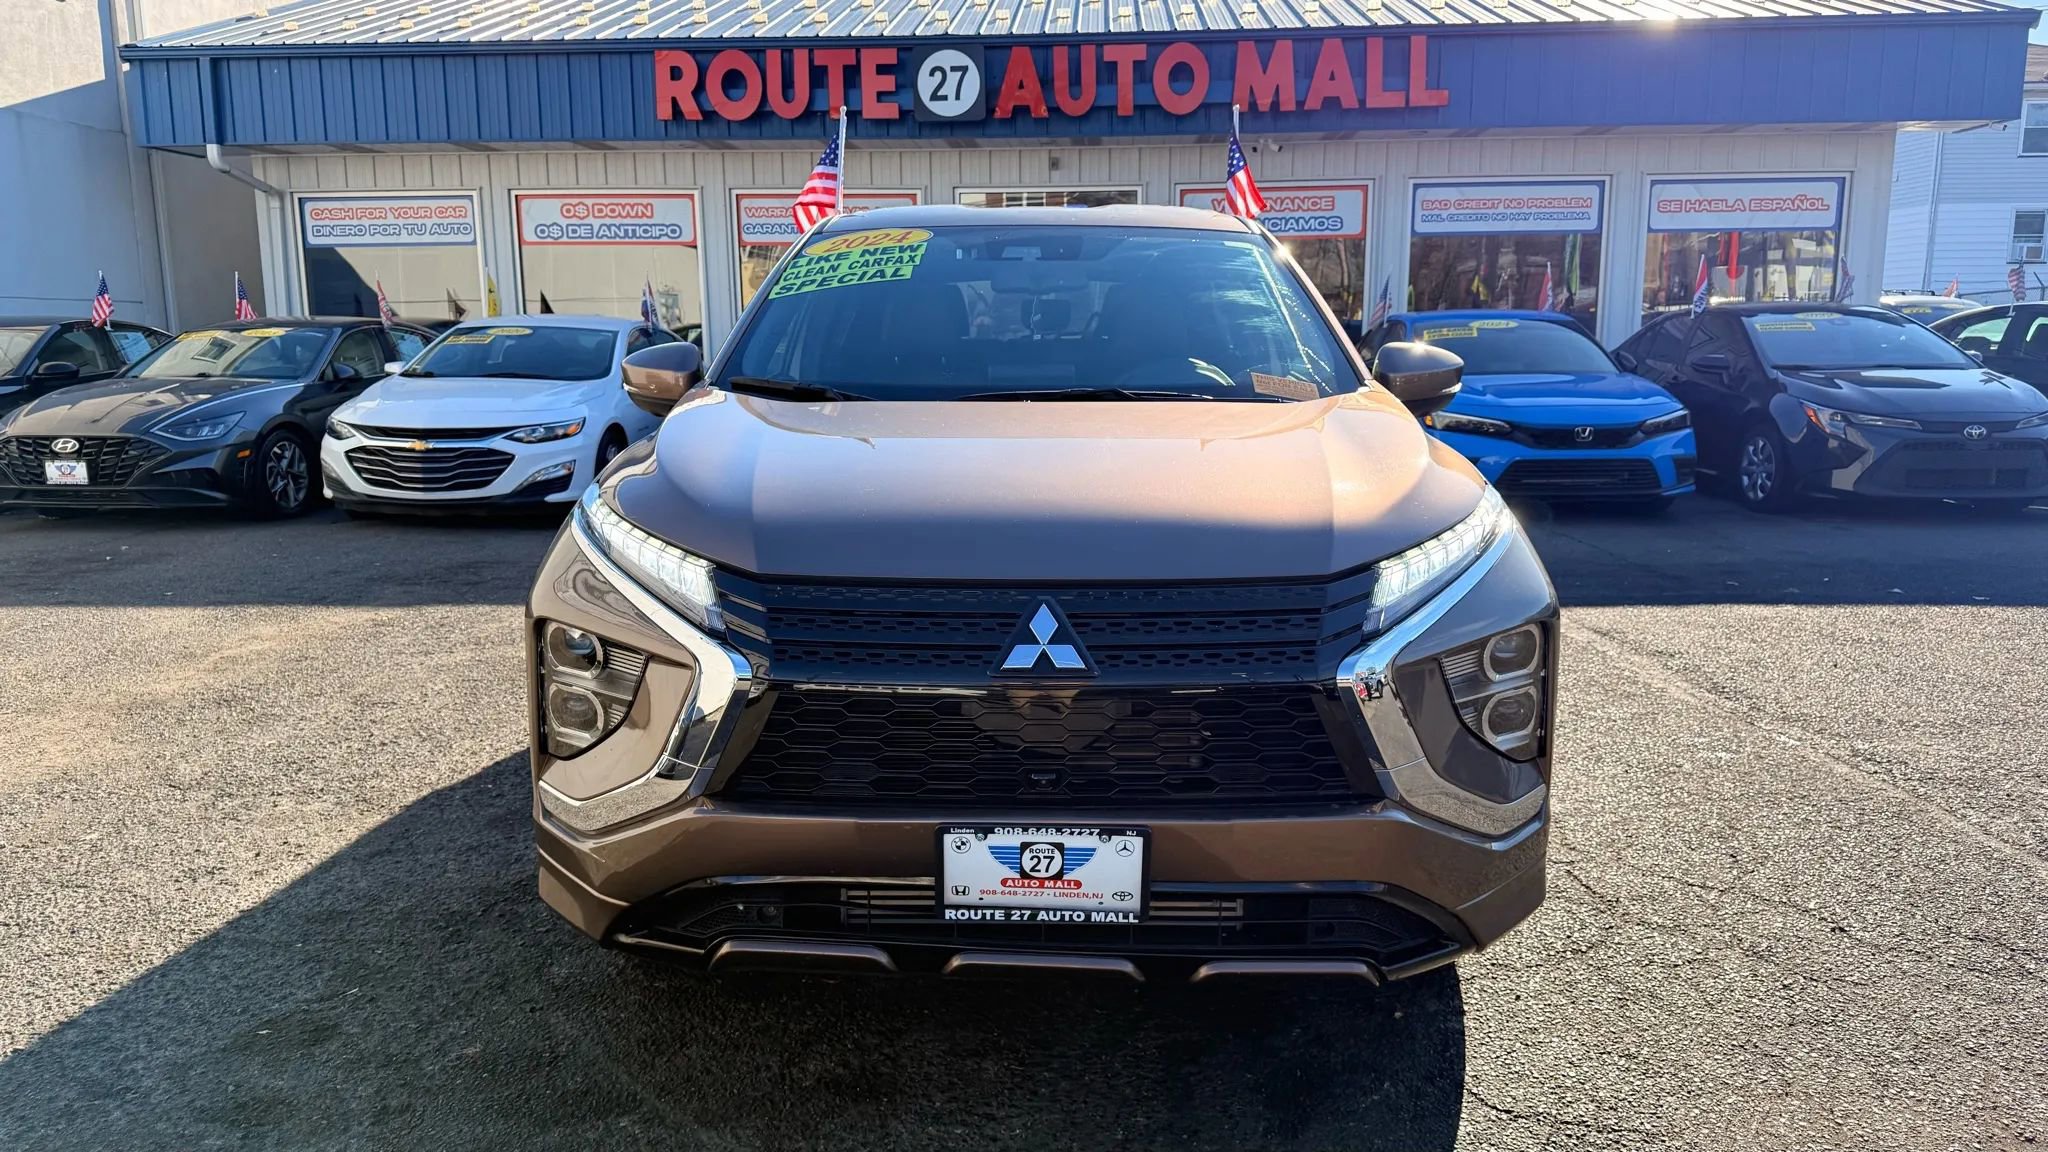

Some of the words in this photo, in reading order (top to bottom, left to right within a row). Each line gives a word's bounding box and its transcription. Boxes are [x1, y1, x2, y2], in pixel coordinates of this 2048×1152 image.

[653, 47, 900, 121] ROUTE
[928, 64, 969, 102] 27
[992, 41, 1210, 119] AUTO
[1232, 34, 1450, 112] MALL
[592, 203, 654, 219] DOWN
[1266, 195, 1335, 212] NANCE
[1422, 199, 1451, 211] BAD
[1453, 199, 1501, 211] CREDIT
[1503, 198, 1525, 210] NO
[1526, 197, 1592, 209] PROBLEM
[1657, 200, 1682, 213] SE
[1684, 199, 1746, 213] HABLA
[1748, 194, 1830, 212] ESPAÑOL
[310, 207, 354, 220] CASH
[356, 207, 386, 220] FOR
[390, 206, 432, 219] YOUR
[434, 205, 467, 219] CAR
[744, 205, 794, 218] WARRA
[1421, 212, 1446, 223] MAL
[1446, 212, 1490, 222] CREDITO
[1491, 212, 1508, 221] NO
[1509, 211, 1532, 221] HAY
[1533, 211, 1591, 221] PROBLEMA
[312, 224, 367, 237] DINERO
[369, 224, 400, 236] POR
[403, 223, 427, 236] TU
[429, 222, 472, 236] AUTO
[743, 223, 800, 236] GARANT
[1265, 215, 1343, 232] CIAMOS
[565, 223, 593, 239] DE
[595, 223, 682, 240] ANTICIPO
[822, 230, 914, 254] 2024
[788, 251, 853, 270] LIKE
[858, 243, 923, 258] NEW
[783, 262, 842, 283] CLEAN
[848, 254, 918, 271] CARFAX
[775, 267, 906, 296] SPECIAL
[994, 827, 1100, 837] 908-648-2727
[1029, 847, 1056, 855] ROUTE
[1029, 855, 1055, 873] 27
[1006, 879, 1040, 888] AUTO
[1044, 880, 1078, 889] MALL
[979, 889, 1045, 897] 908-648-2727
[1053, 890, 1104, 900] LINDEN,NJ
[944, 909, 1006, 921] ROUTE
[1010, 910, 1032, 921] 27
[1037, 911, 1086, 922] AUTO
[1090, 911, 1139, 923] MALL
